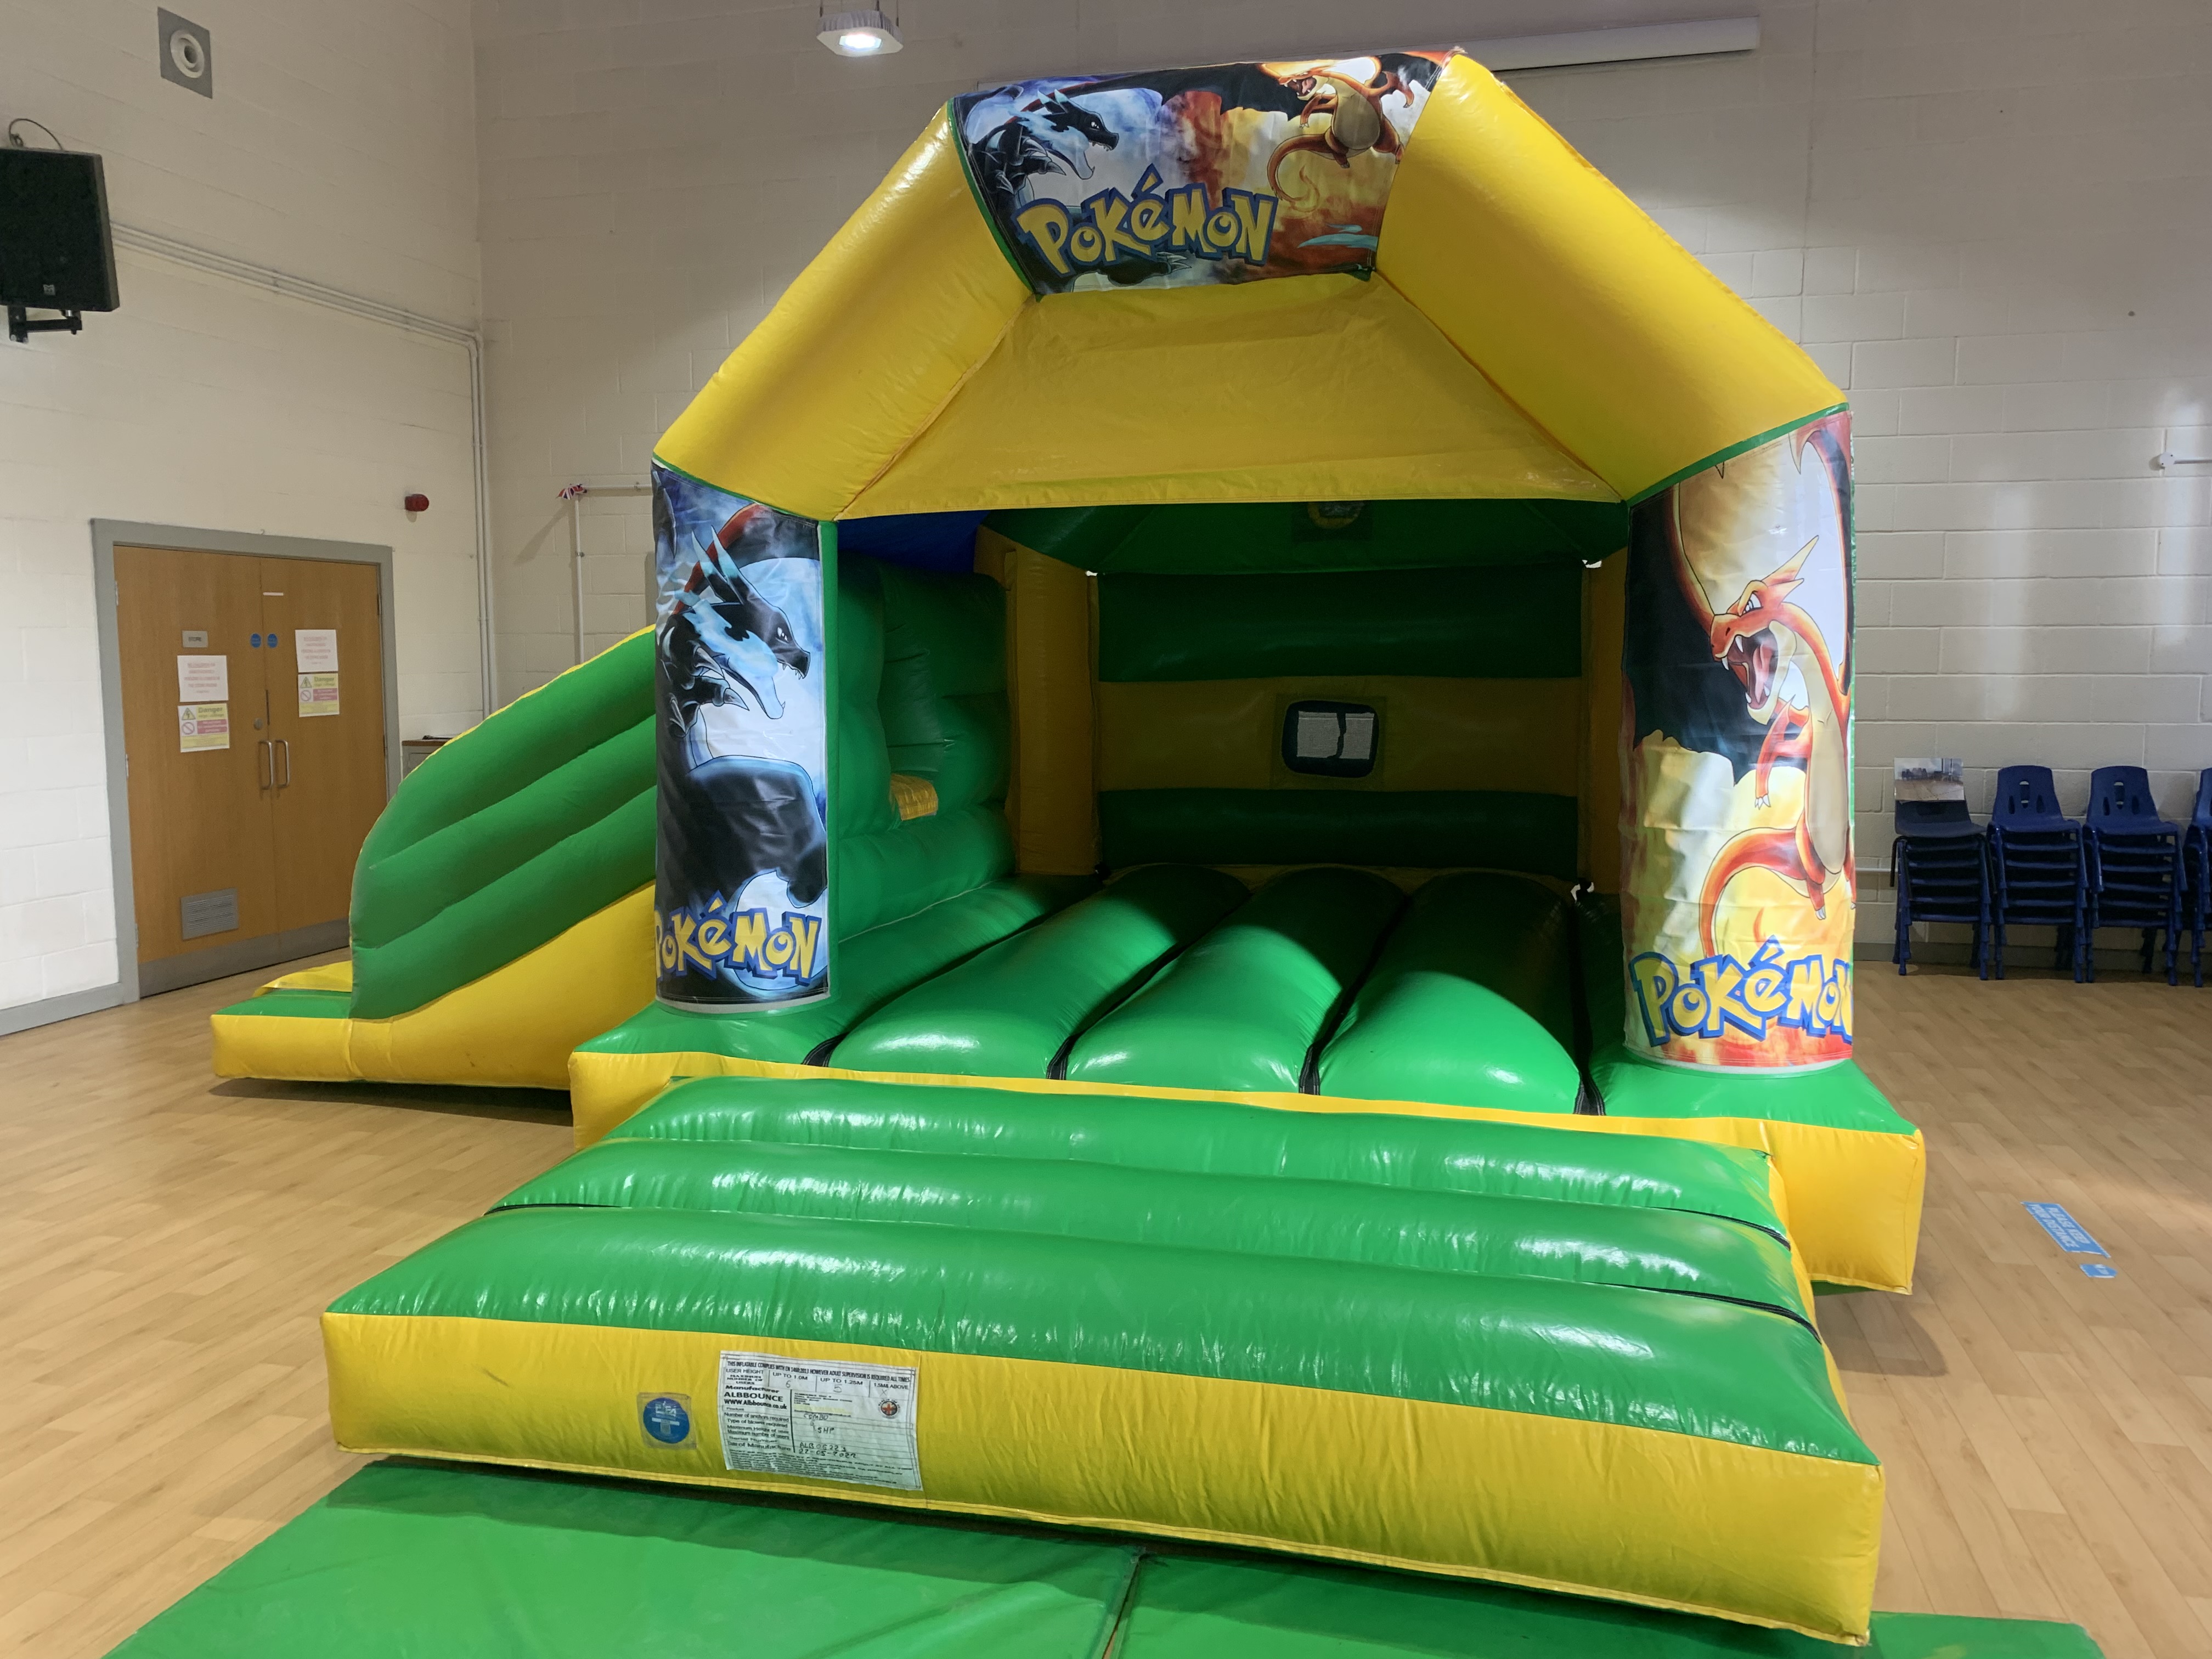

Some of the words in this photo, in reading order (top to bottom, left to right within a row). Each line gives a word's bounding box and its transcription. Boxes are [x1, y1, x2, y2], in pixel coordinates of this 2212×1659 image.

[725, 1385, 780, 1393] Manufacturer
[833, 1384, 842, 1393] 5
[724, 1392, 783, 1402] ALBBOUNCE
[724, 1399, 787, 1409] WWW.Albbounce.co.uk
